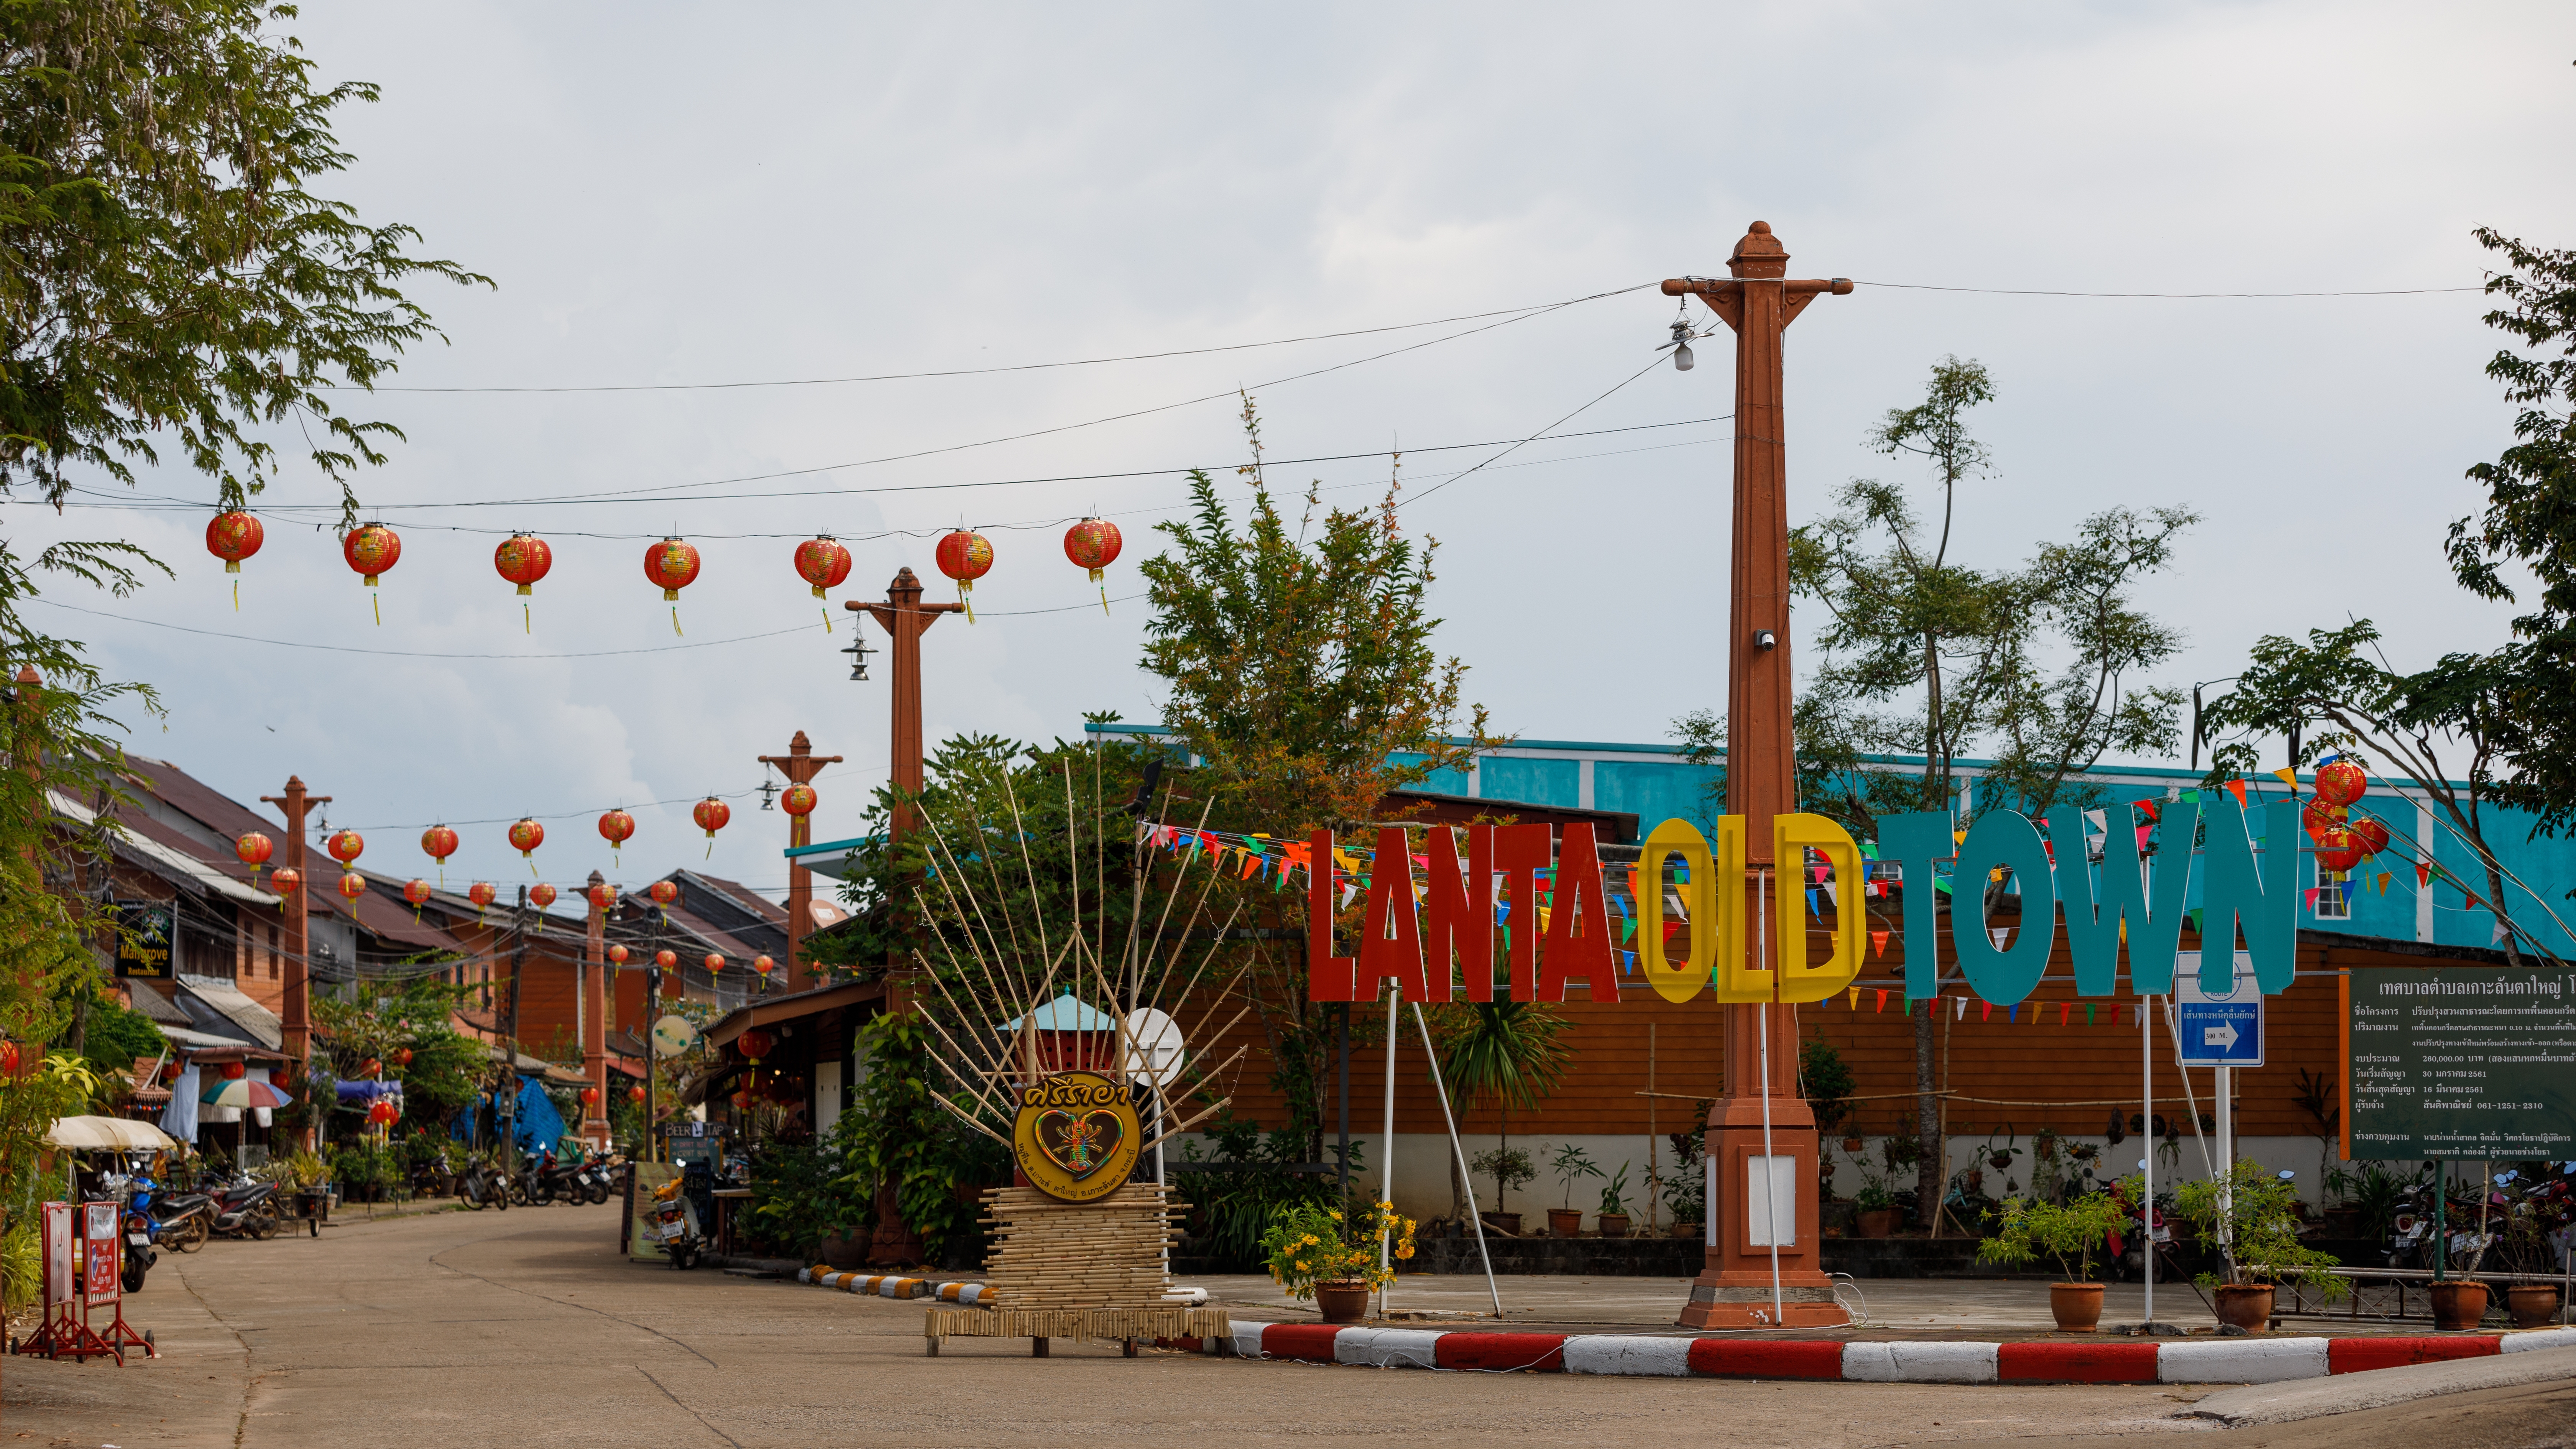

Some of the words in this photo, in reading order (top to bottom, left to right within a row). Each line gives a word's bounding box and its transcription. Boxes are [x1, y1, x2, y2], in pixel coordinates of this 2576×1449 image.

[1309, 822, 1621, 1003] LANTA
[1637, 812, 1867, 1004] OLD
[1877, 801, 2301, 1006] TOWN
[128, 966, 160, 976] Restaurant
[2379, 974, 2561, 999] เทศบาลตำบลเกาะลันตาใหญ่
[2183, 1006, 2256, 1019] เส้นทางหนีคลื่นยักษ์
[2354, 1001, 2399, 1015] ชื่อโครงการ
[2354, 1021, 2399, 1031] ปริมาณงาน
[2354, 1052, 2400, 1062] งบประมาณ
[2356, 1065, 2405, 1080] วันเริ่มสัญญา
[1023, 1076, 1129, 1107] ศรีรายา
[2355, 1080, 2415, 1097] วันสิ้นสุดสัญญา
[2436, 1083, 2463, 1093] มีนาคม
[2355, 1099, 2384, 1113] ผู้รับจ้าง
[2423, 1097, 2472, 1109] สันติพาณิชย์
[665, 1122, 691, 1137] BEER
[705, 1123, 724, 1135] TAP
[2355, 1130, 2409, 1144] ช่างควบคุมงาน
[2480, 1130, 2500, 1141] จิตมั่น
[2463, 1145, 2486, 1155] คล่องดี
[2490, 1147, 2550, 1158] ผู้ช่วยนายช่างโยธา
[1081, 1174, 1121, 1196] อ.เกาะลันตา
